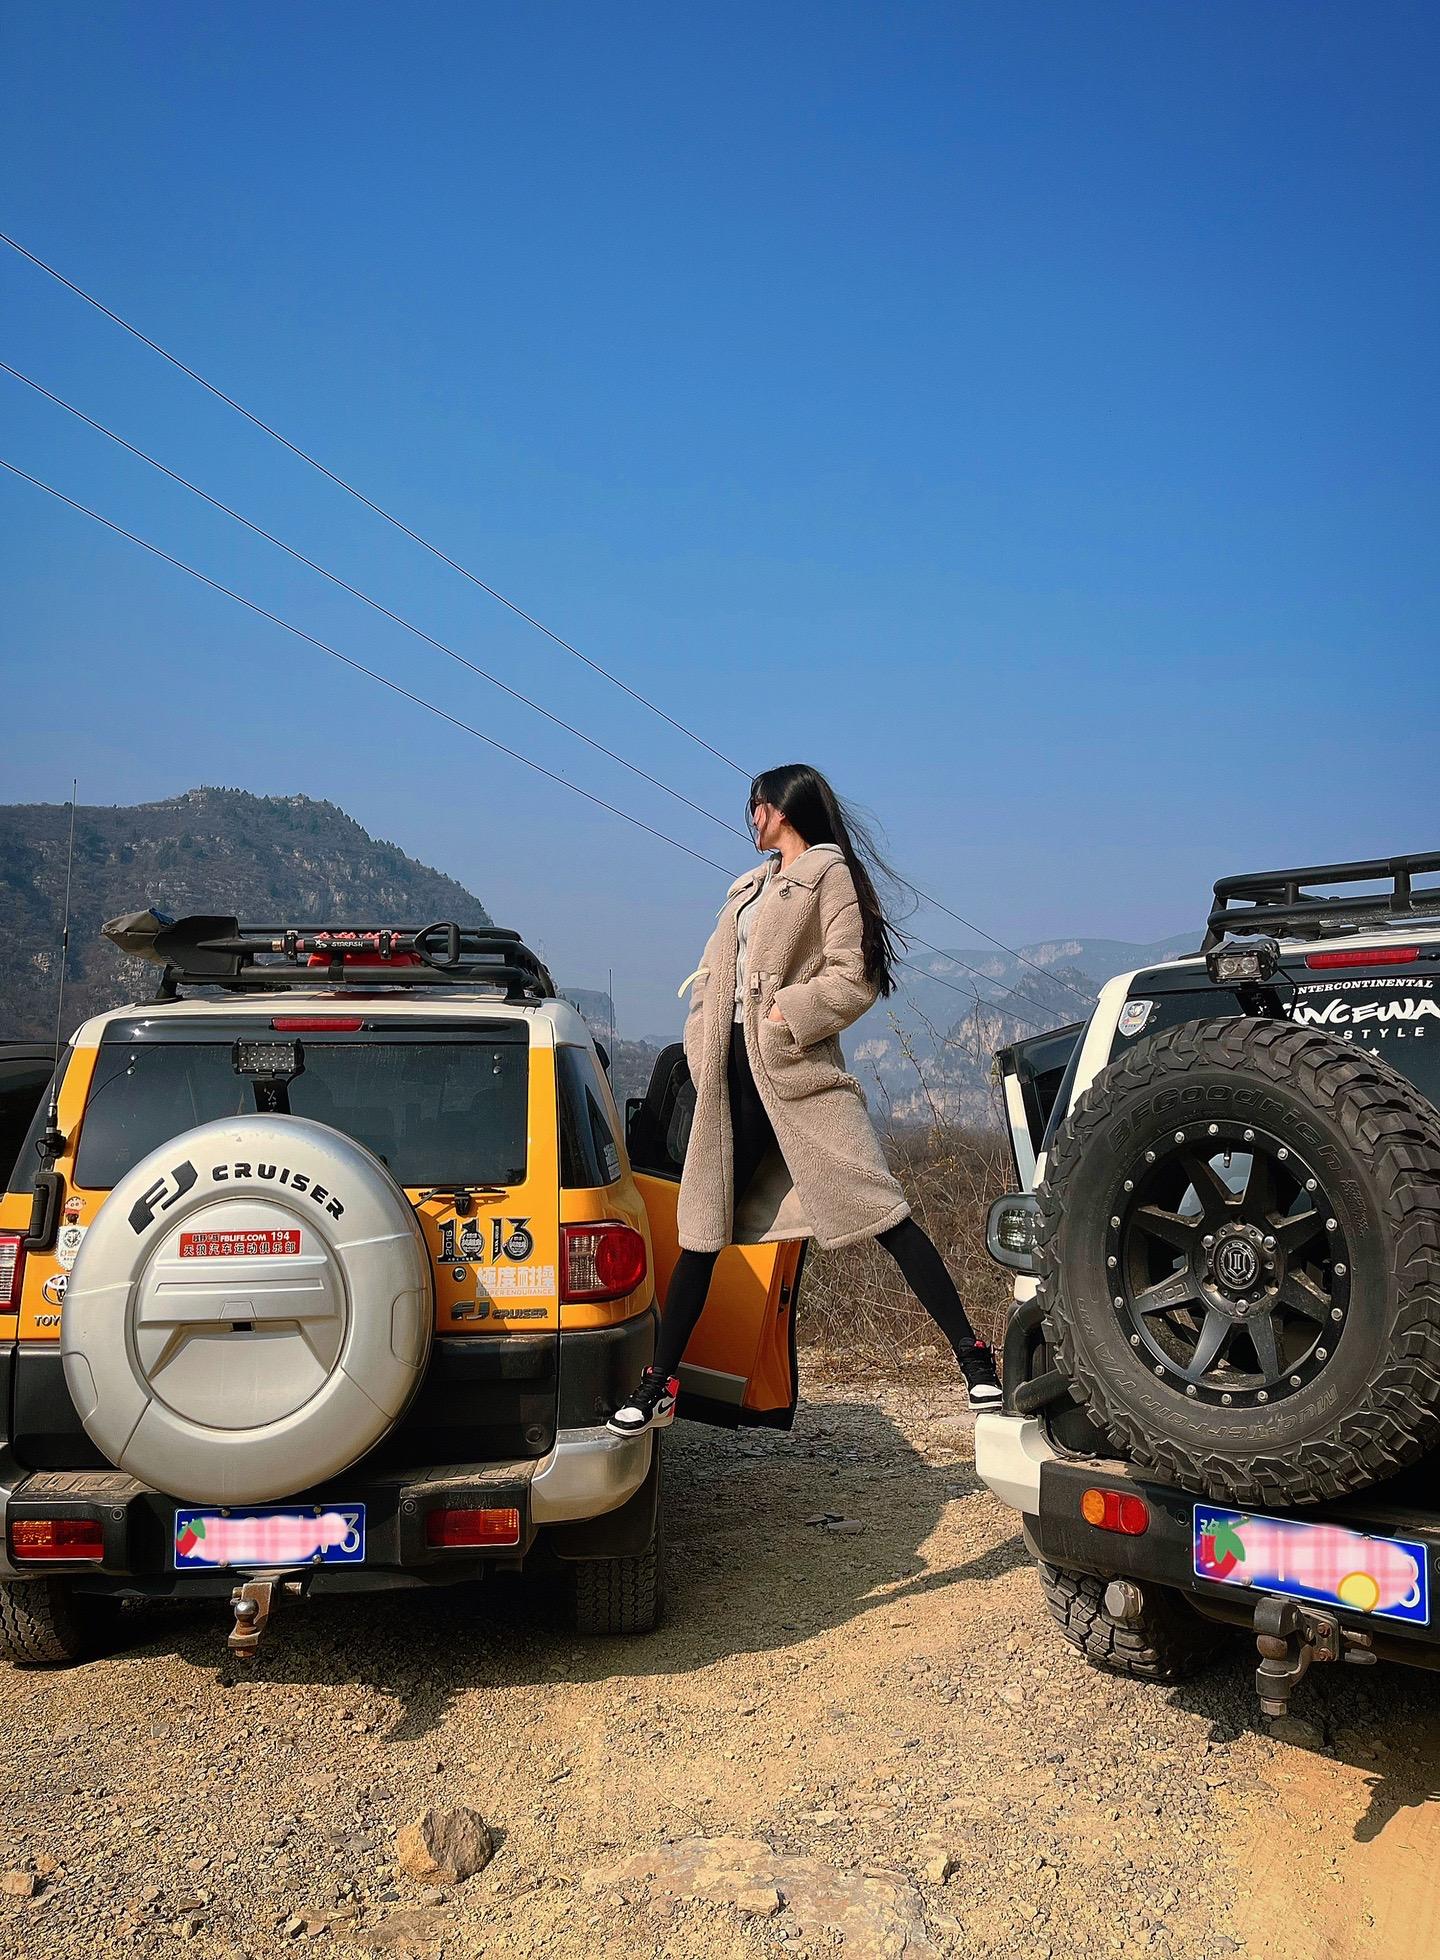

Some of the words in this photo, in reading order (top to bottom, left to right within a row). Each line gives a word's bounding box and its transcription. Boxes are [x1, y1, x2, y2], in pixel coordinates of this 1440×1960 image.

[1328, 1027, 1425, 1040] STYLE
[1108, 1085, 1343, 1171] BFGoodrich
[128, 1160, 198, 1235] FJ
[212, 1162, 345, 1221] CRUISER
[271, 1231, 290, 1241] 194
